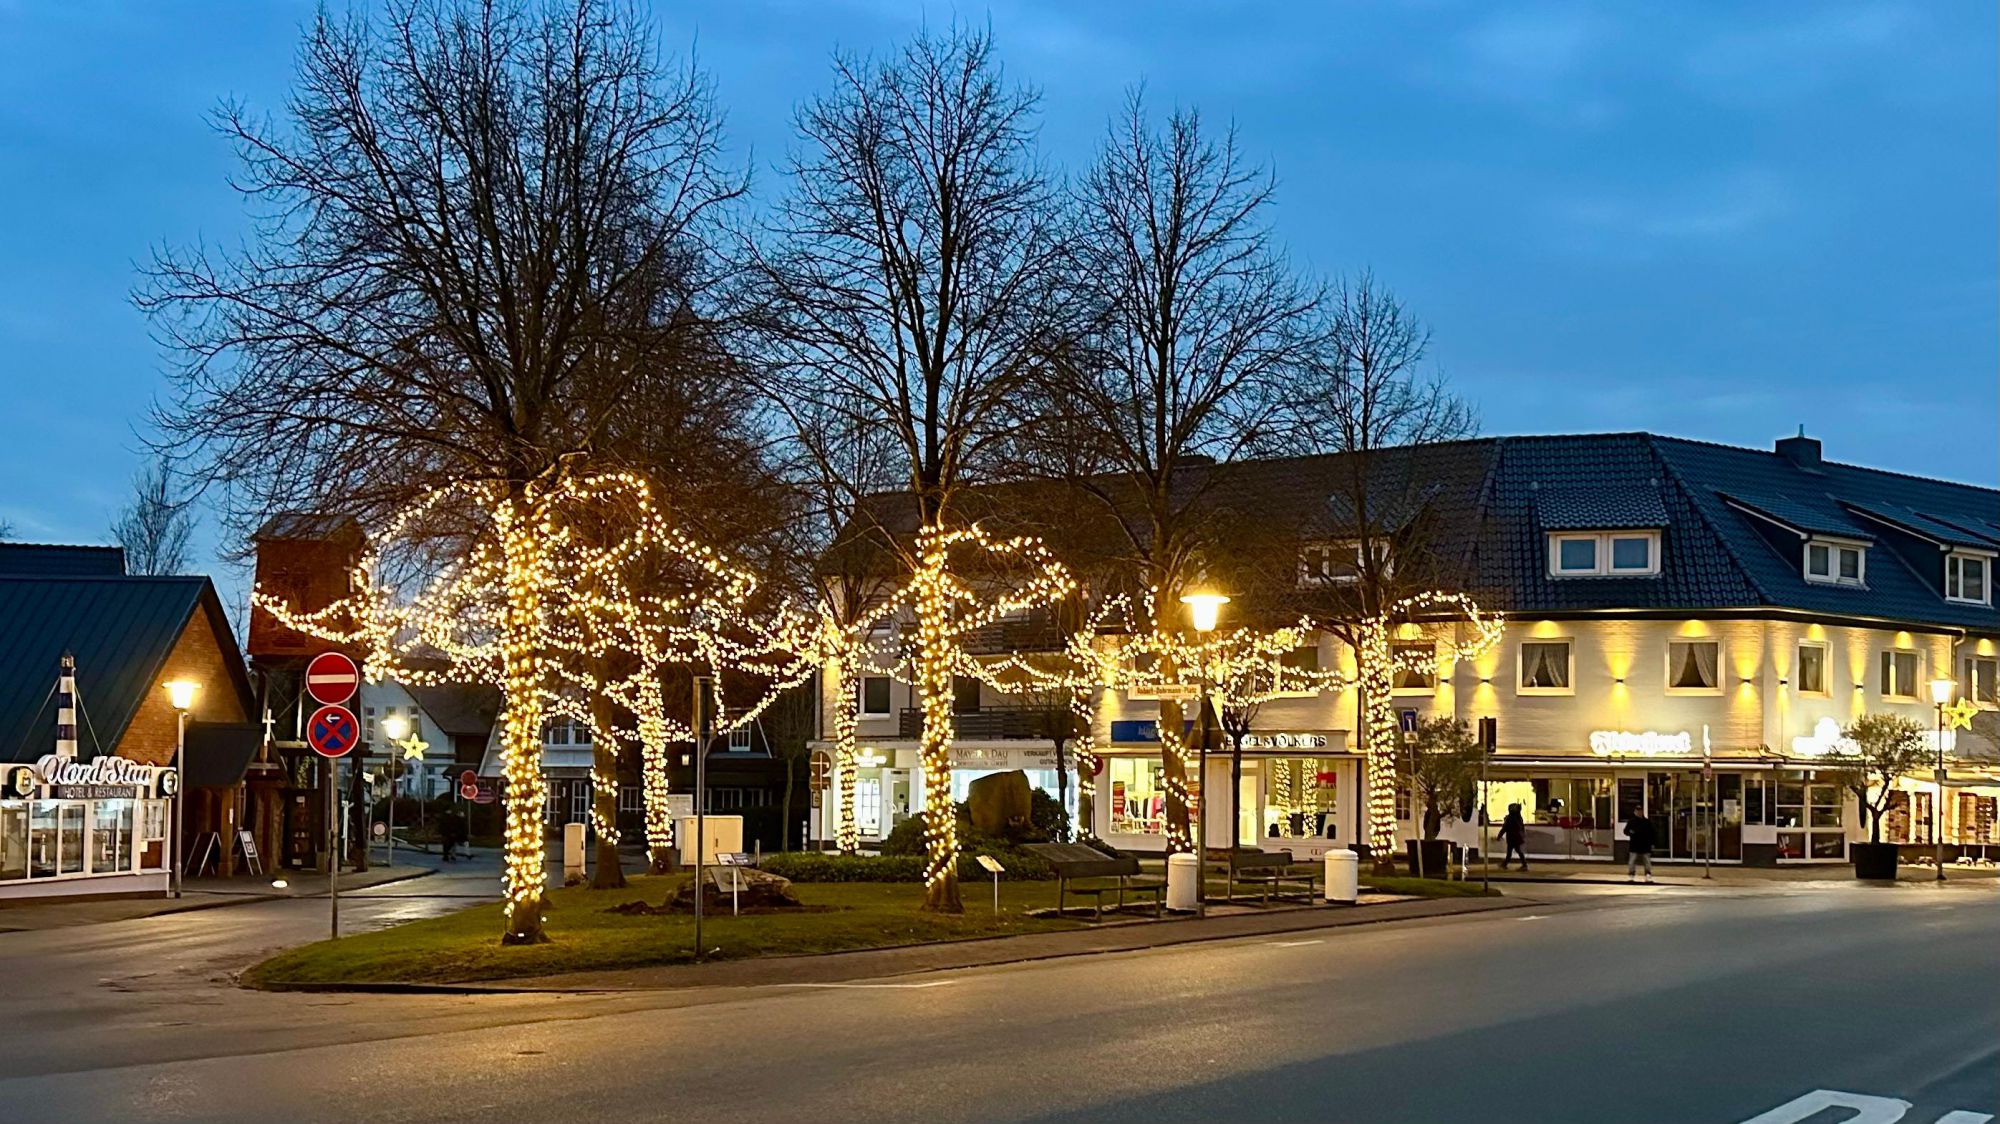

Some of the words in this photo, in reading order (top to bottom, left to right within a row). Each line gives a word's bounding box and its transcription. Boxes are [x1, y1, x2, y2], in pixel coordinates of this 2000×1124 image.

[42, 755, 107, 785] Nord
[64, 787, 86, 799] HOTEL
[87, 788, 93, 799] &
[94, 787, 136, 799] RESTAURANT
